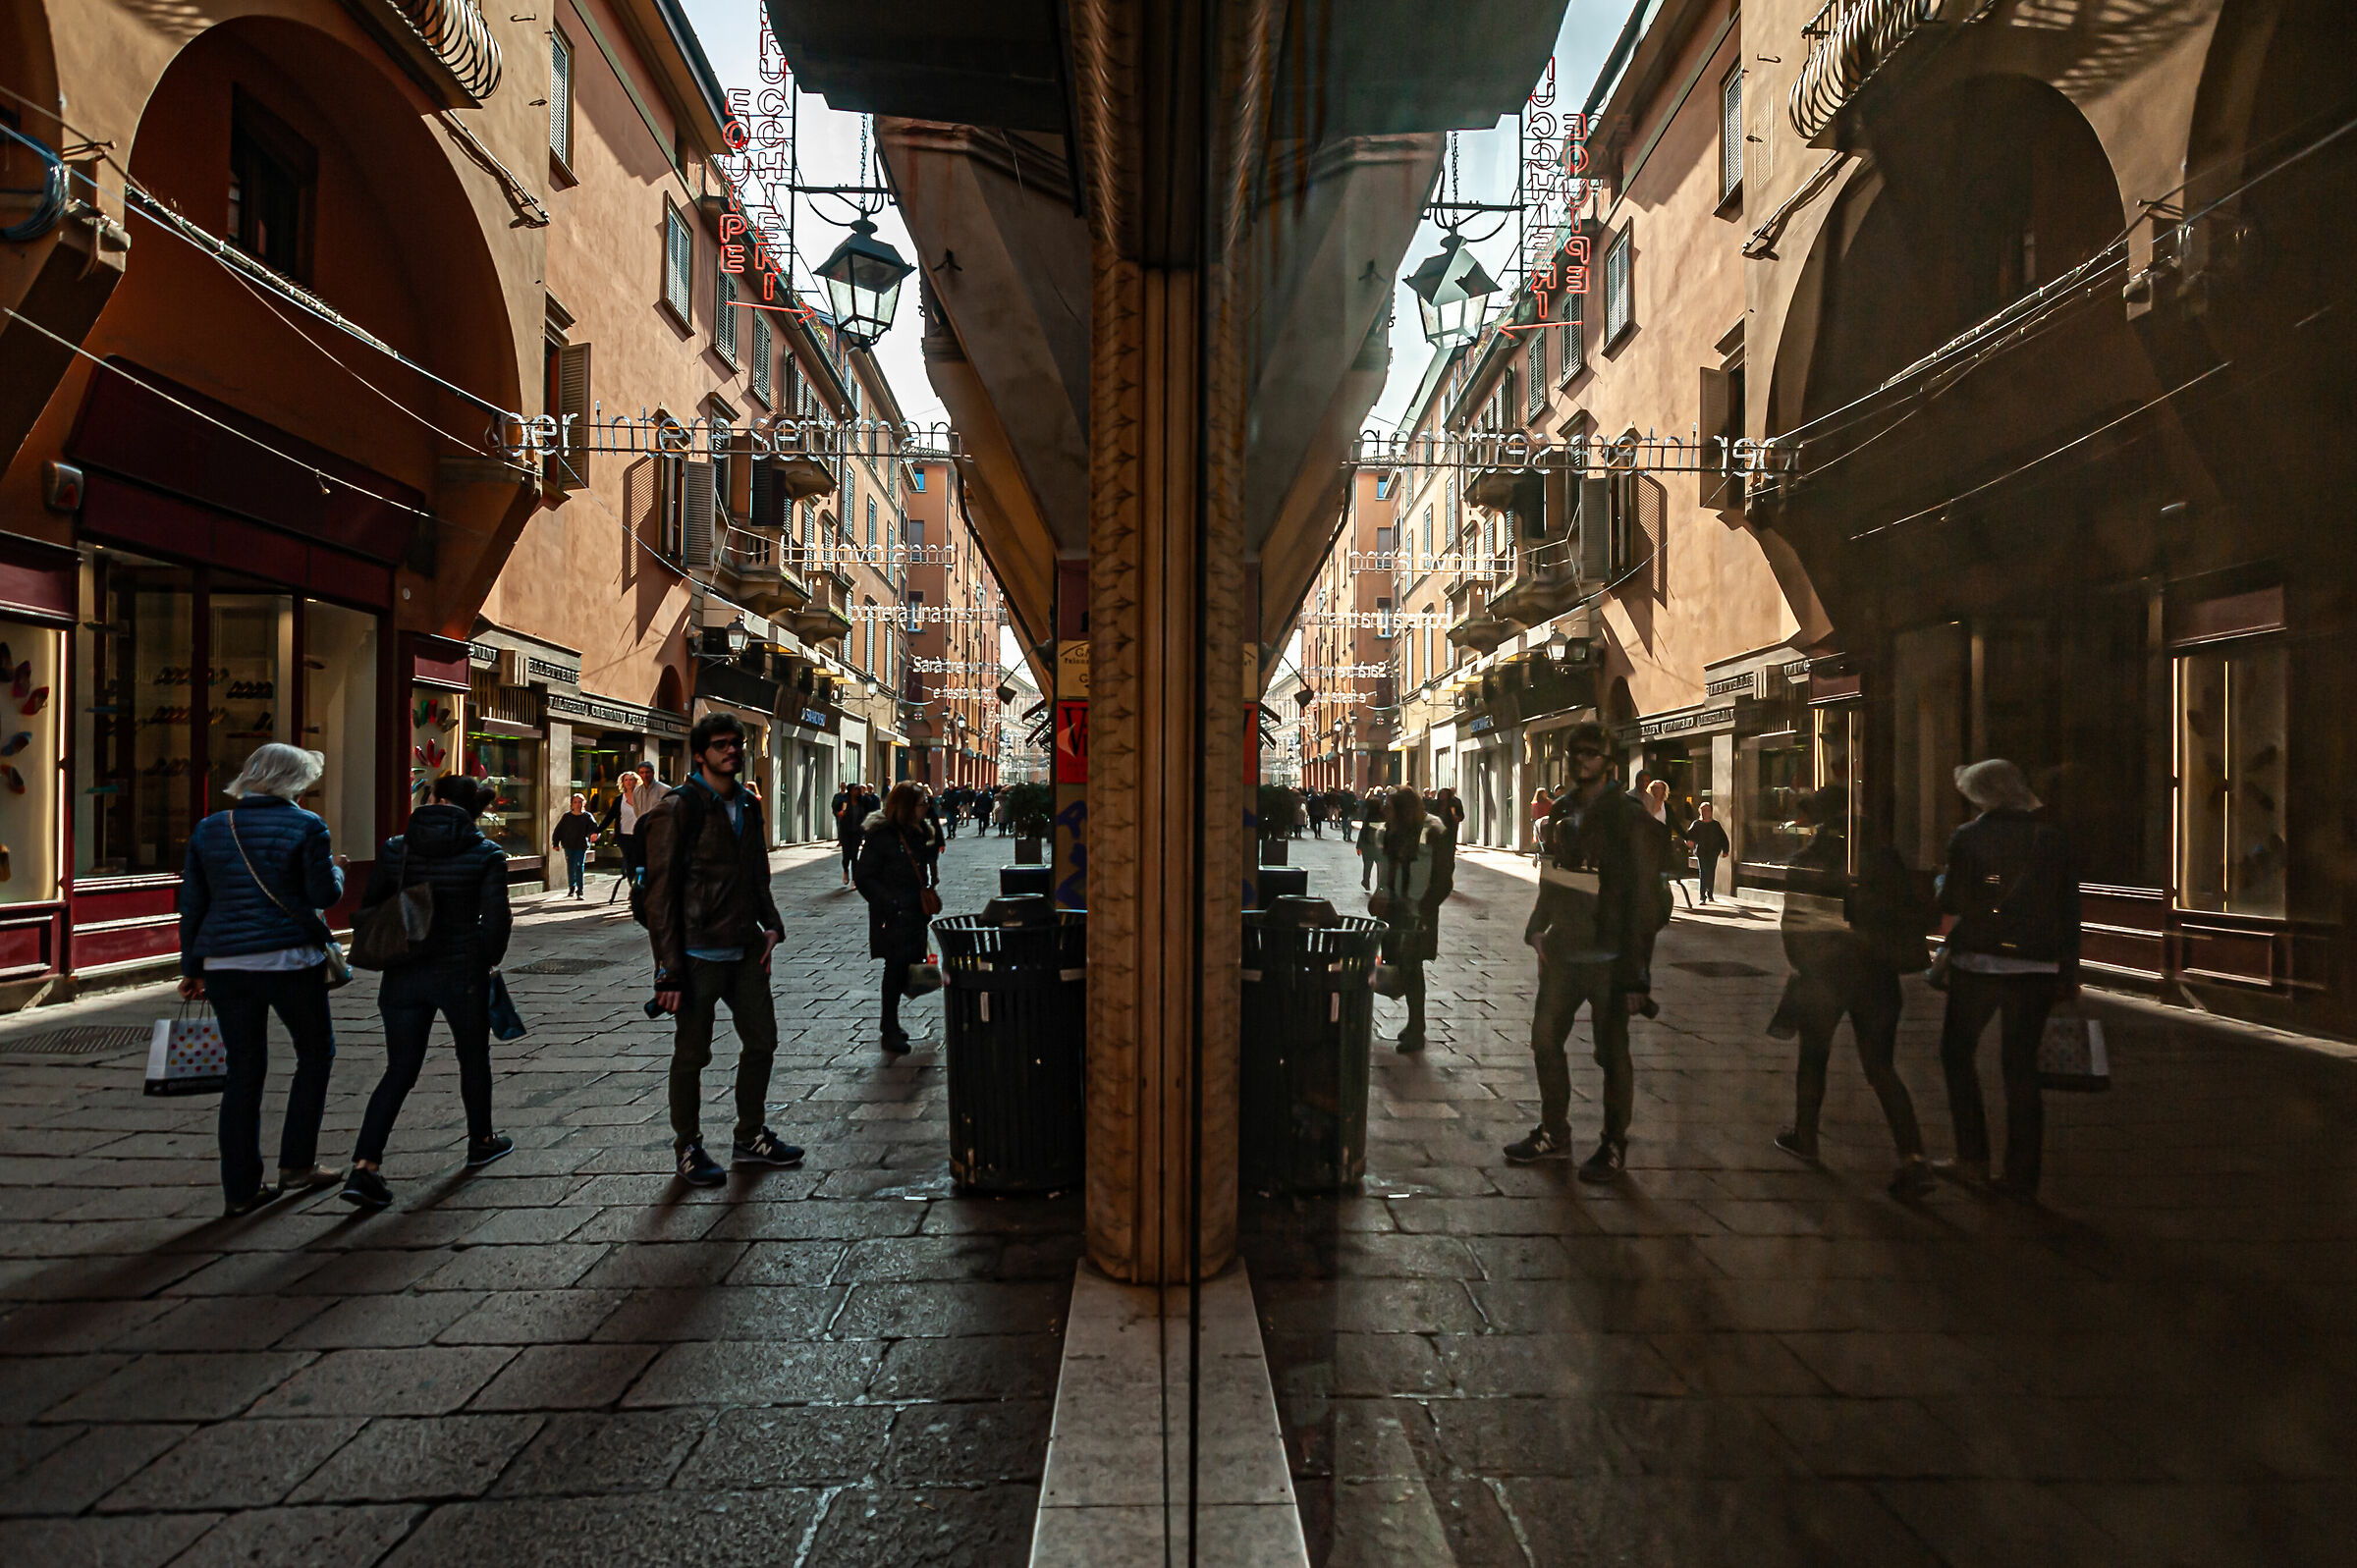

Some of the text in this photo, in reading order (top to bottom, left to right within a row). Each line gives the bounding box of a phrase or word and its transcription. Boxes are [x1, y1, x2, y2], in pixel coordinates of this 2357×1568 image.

[720, 88, 750, 274] EQUIPE
[595, 401, 734, 460] intere
[750, 404, 957, 463] settiman
[893, 543, 956, 570] anno
[528, 659, 580, 685] ELLETTERIE
[912, 655, 943, 674] Sarà
